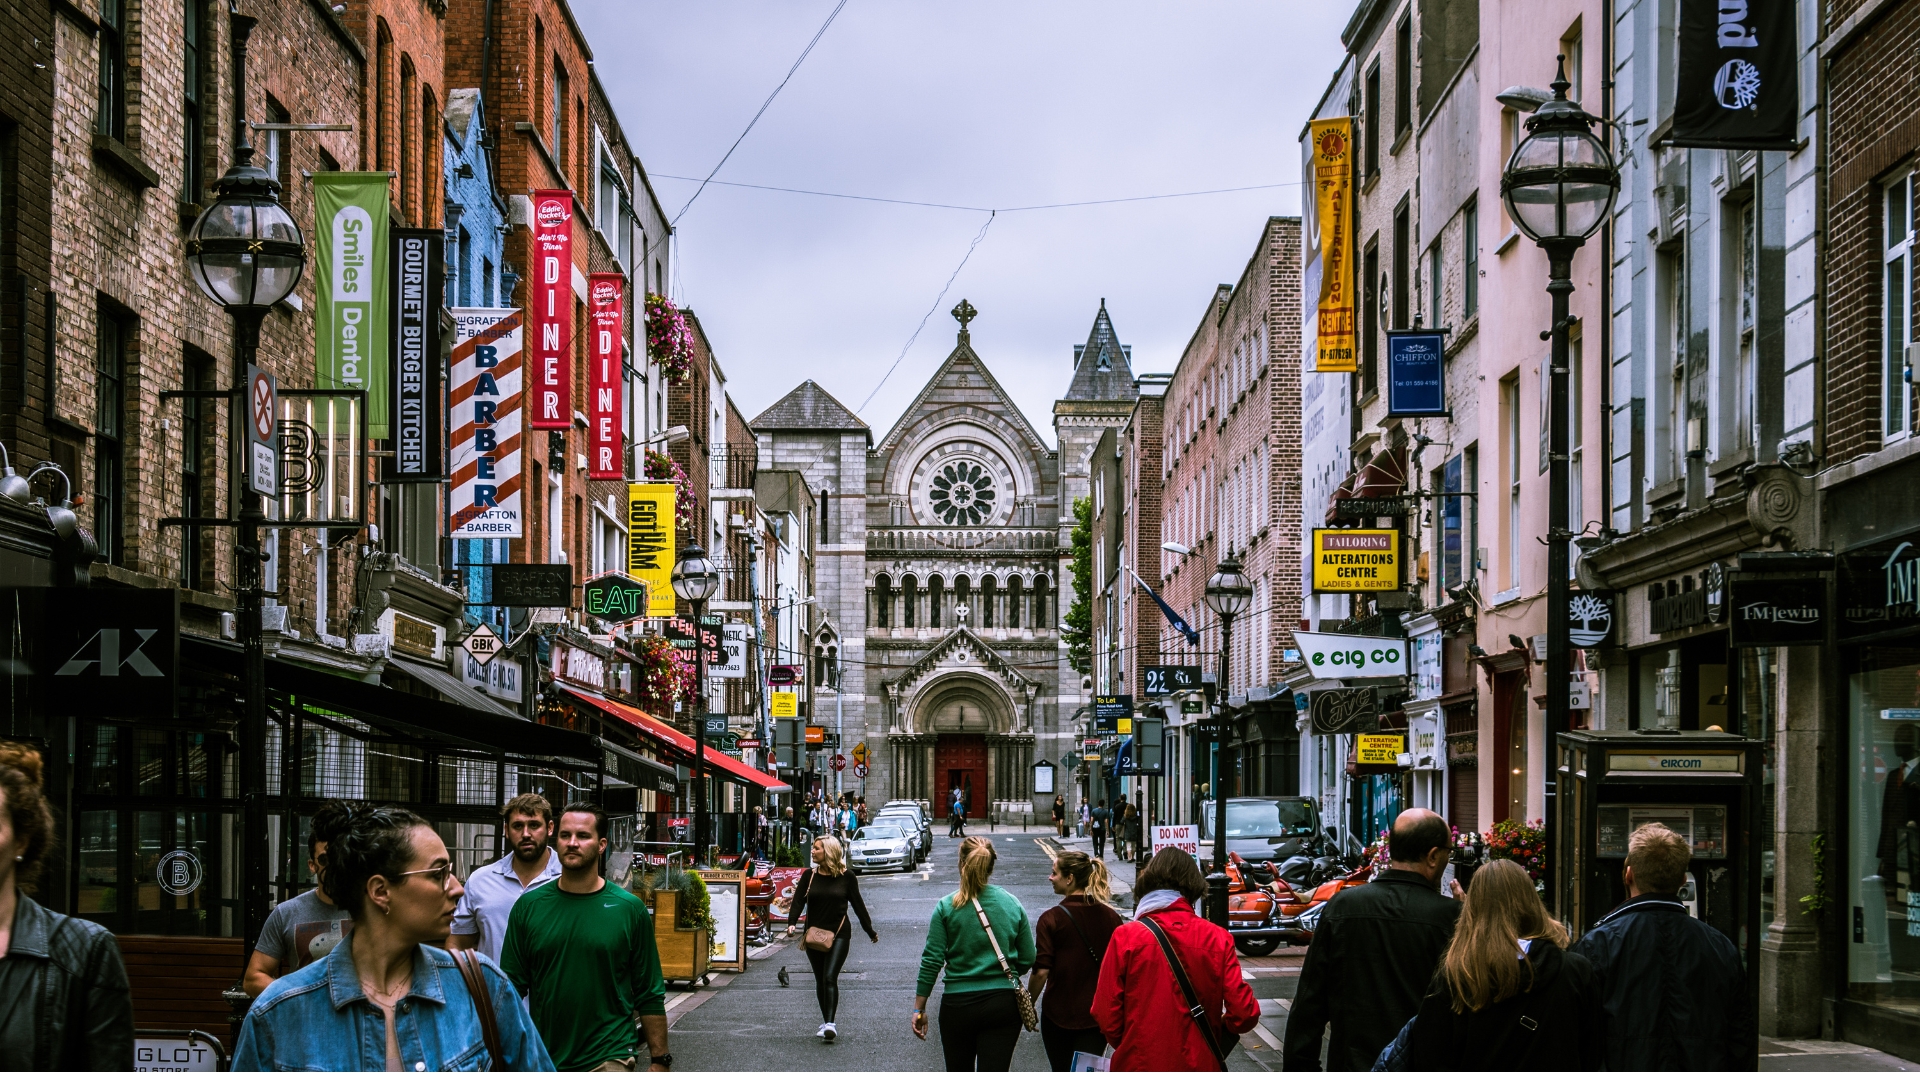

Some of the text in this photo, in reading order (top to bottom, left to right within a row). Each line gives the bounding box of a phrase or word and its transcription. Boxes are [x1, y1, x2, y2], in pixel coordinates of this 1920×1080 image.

[1316, 127, 1348, 146] ALTERATION
[541, 205, 560, 213] Eddie
[537, 233, 568, 242] Ain't No
[543, 242, 563, 251] Finer
[1331, 190, 1342, 303] ALTERATION
[342, 219, 363, 384] Smiles Dental
[457, 316, 466, 337] THE
[466, 316, 518, 326] GRAFTON
[1320, 311, 1352, 333] CENTRE
[468, 329, 513, 339] BARBER
[543, 256, 560, 419] DINER
[403, 238, 422, 473] GOURMET BURGER KITCHEN
[1394, 353, 1437, 362] CHIFFON
[598, 330, 613, 471] DINER
[473, 344, 500, 508] BARBER
[277, 419, 325, 494] B
[1340, 500, 1404, 514] RESTAURANT
[465, 510, 517, 520] GRAFTON
[456, 511, 465, 532] THE
[467, 523, 512, 532] BARBER
[631, 500, 668, 570] GOTHAM
[1328, 537, 1387, 547] TAILORING
[1322, 554, 1394, 564] ALTERATIONS
[500, 571, 565, 583] GRAFTON
[1337, 567, 1378, 578] CENTRE
[1322, 580, 1352, 588] LADIES
[1364, 580, 1393, 588] GENTS
[504, 586, 560, 597] BARBER
[588, 585, 642, 614] EAT
[472, 638, 494, 651] GBK
[670, 639, 697, 648] SPIRITS
[55, 629, 165, 676] AK
[1312, 652, 1325, 666] e
[1331, 650, 1365, 669] cig
[1371, 648, 1400, 664] co
[467, 655, 516, 691] GALLERY @ NO. SIX
[706, 721, 725, 730] SO
[1160, 828, 1190, 839] DO NOT
[1600, 826, 1614, 834] 50c
[1179, 842, 1197, 853] THIS
[138, 1047, 208, 1063] GLOT
